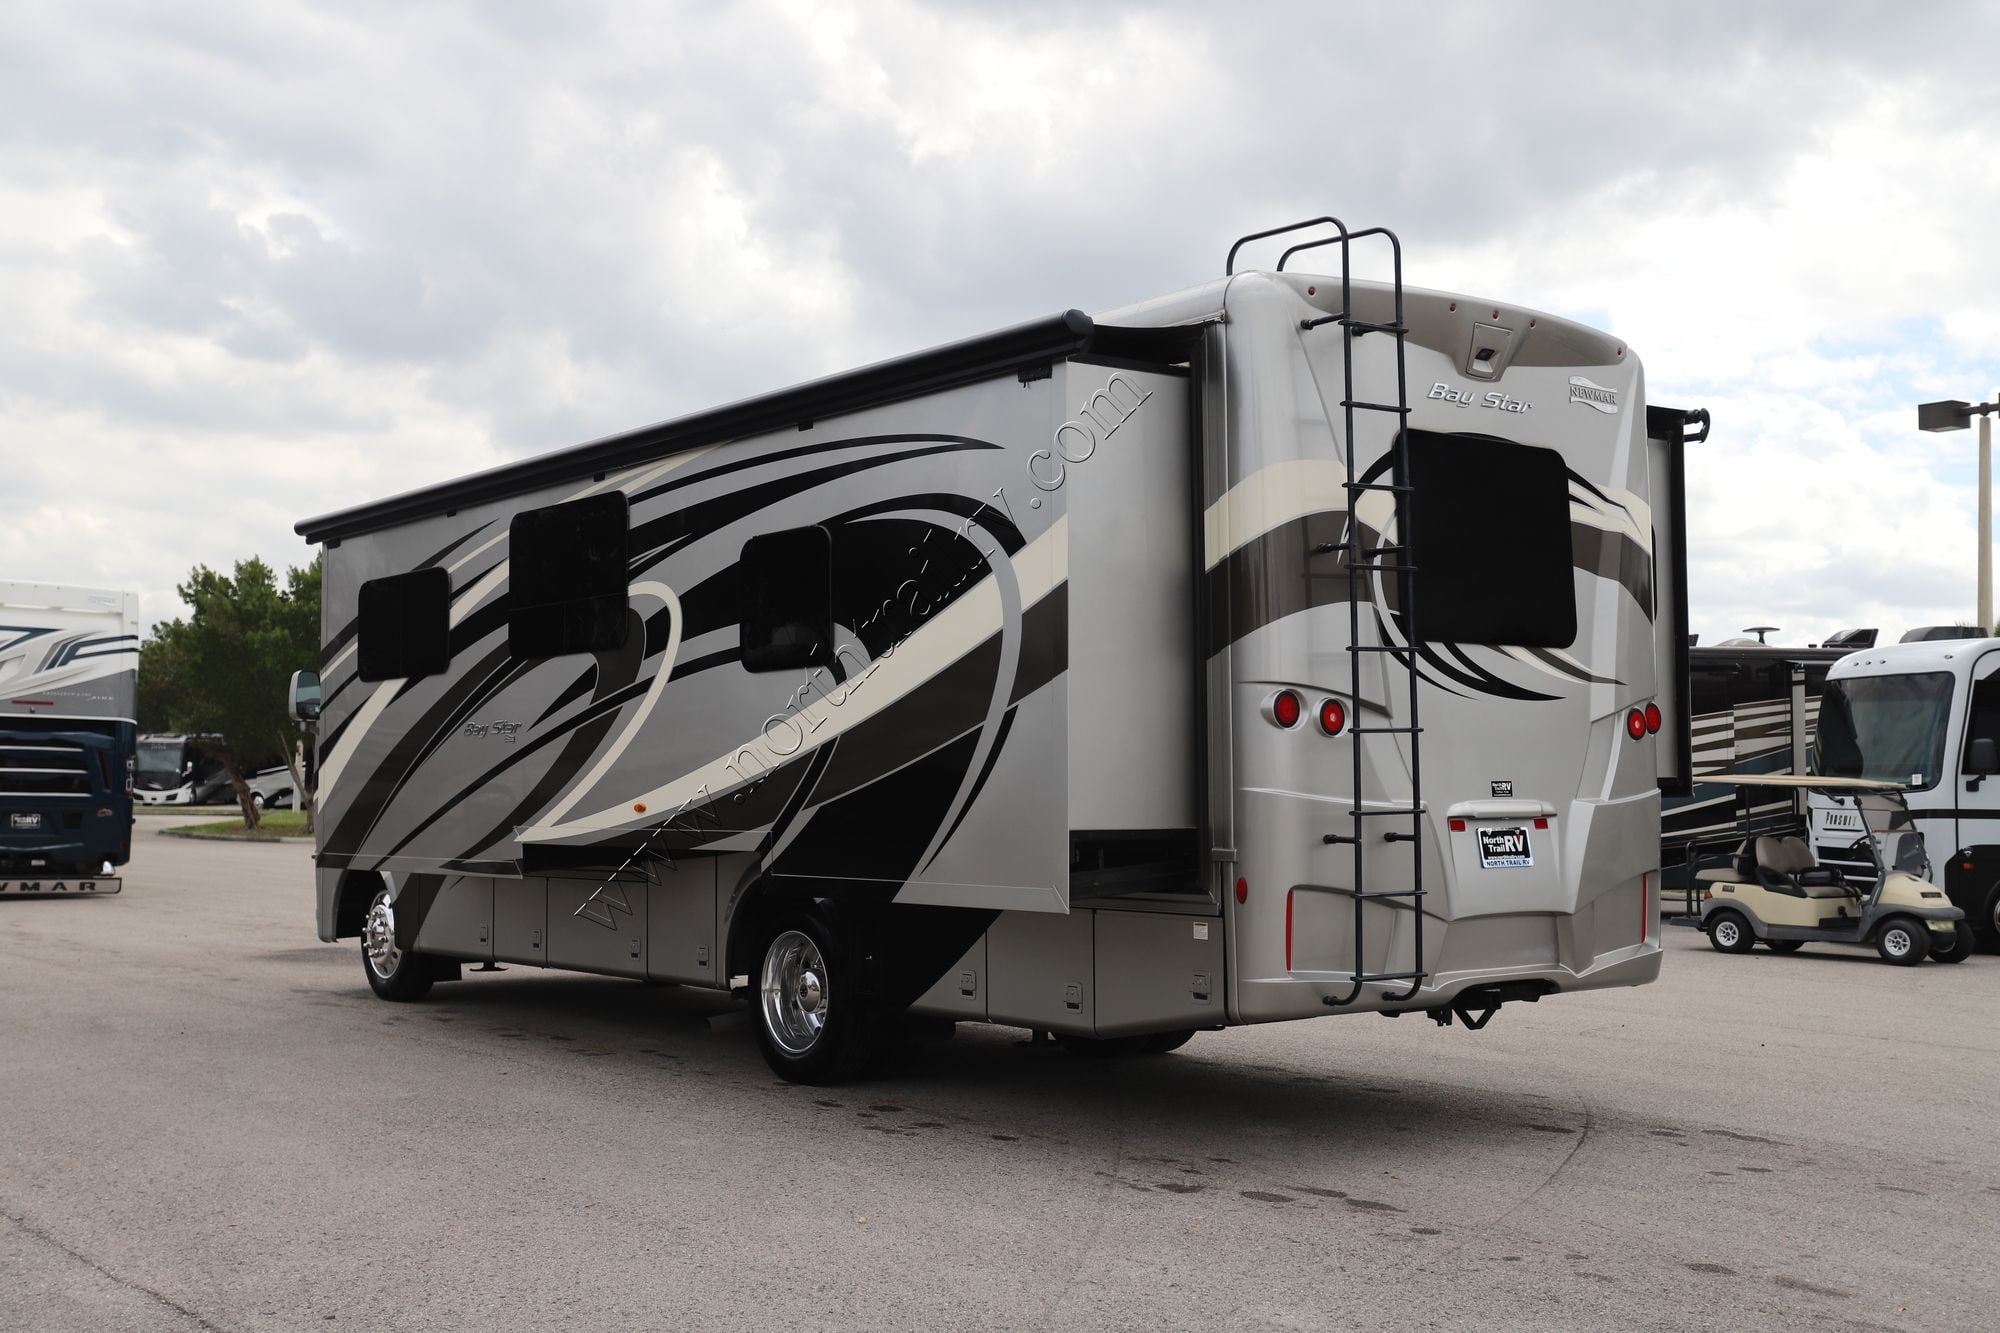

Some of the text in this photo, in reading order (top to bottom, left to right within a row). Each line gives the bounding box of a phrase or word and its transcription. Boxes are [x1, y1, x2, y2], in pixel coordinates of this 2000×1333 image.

[1427, 381, 1534, 414] Bay Star
[1569, 386, 1616, 405] NEWMAR
[464, 719, 522, 738] Bay Star
[1483, 836, 1504, 845] North
[1487, 844, 1505, 853] Trail
[1504, 835, 1524, 852] RV
